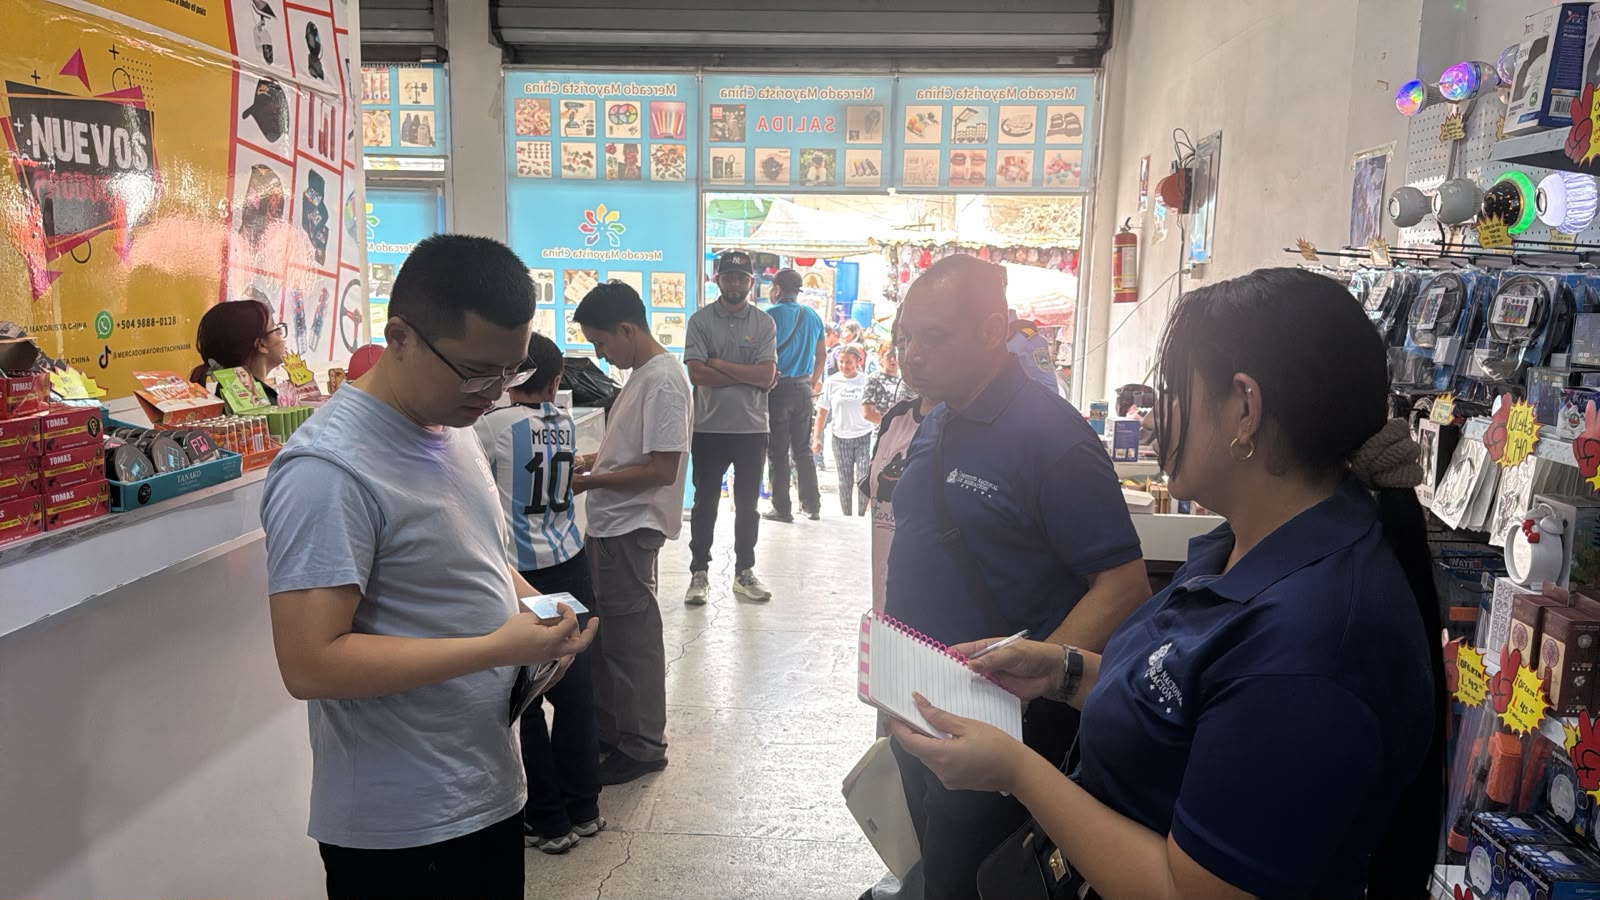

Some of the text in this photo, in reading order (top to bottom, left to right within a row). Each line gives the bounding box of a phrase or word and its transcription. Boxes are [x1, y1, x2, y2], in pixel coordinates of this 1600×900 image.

[31, 113, 148, 170] NUEVOS
[29, 323, 67, 333] MAYORISTA
[68, 321, 88, 330] CHINA
[116, 316, 177, 330] +504 9888-0128
[70, 356, 90, 365] CHINA
[12, 382, 33, 392] TOMAS
[46, 417, 69, 429] TOMAS
[531, 429, 571, 446] MESSI
[49, 453, 72, 465] TOMAS
[524, 451, 574, 514] 10
[51, 491, 75, 503] TOMAS
